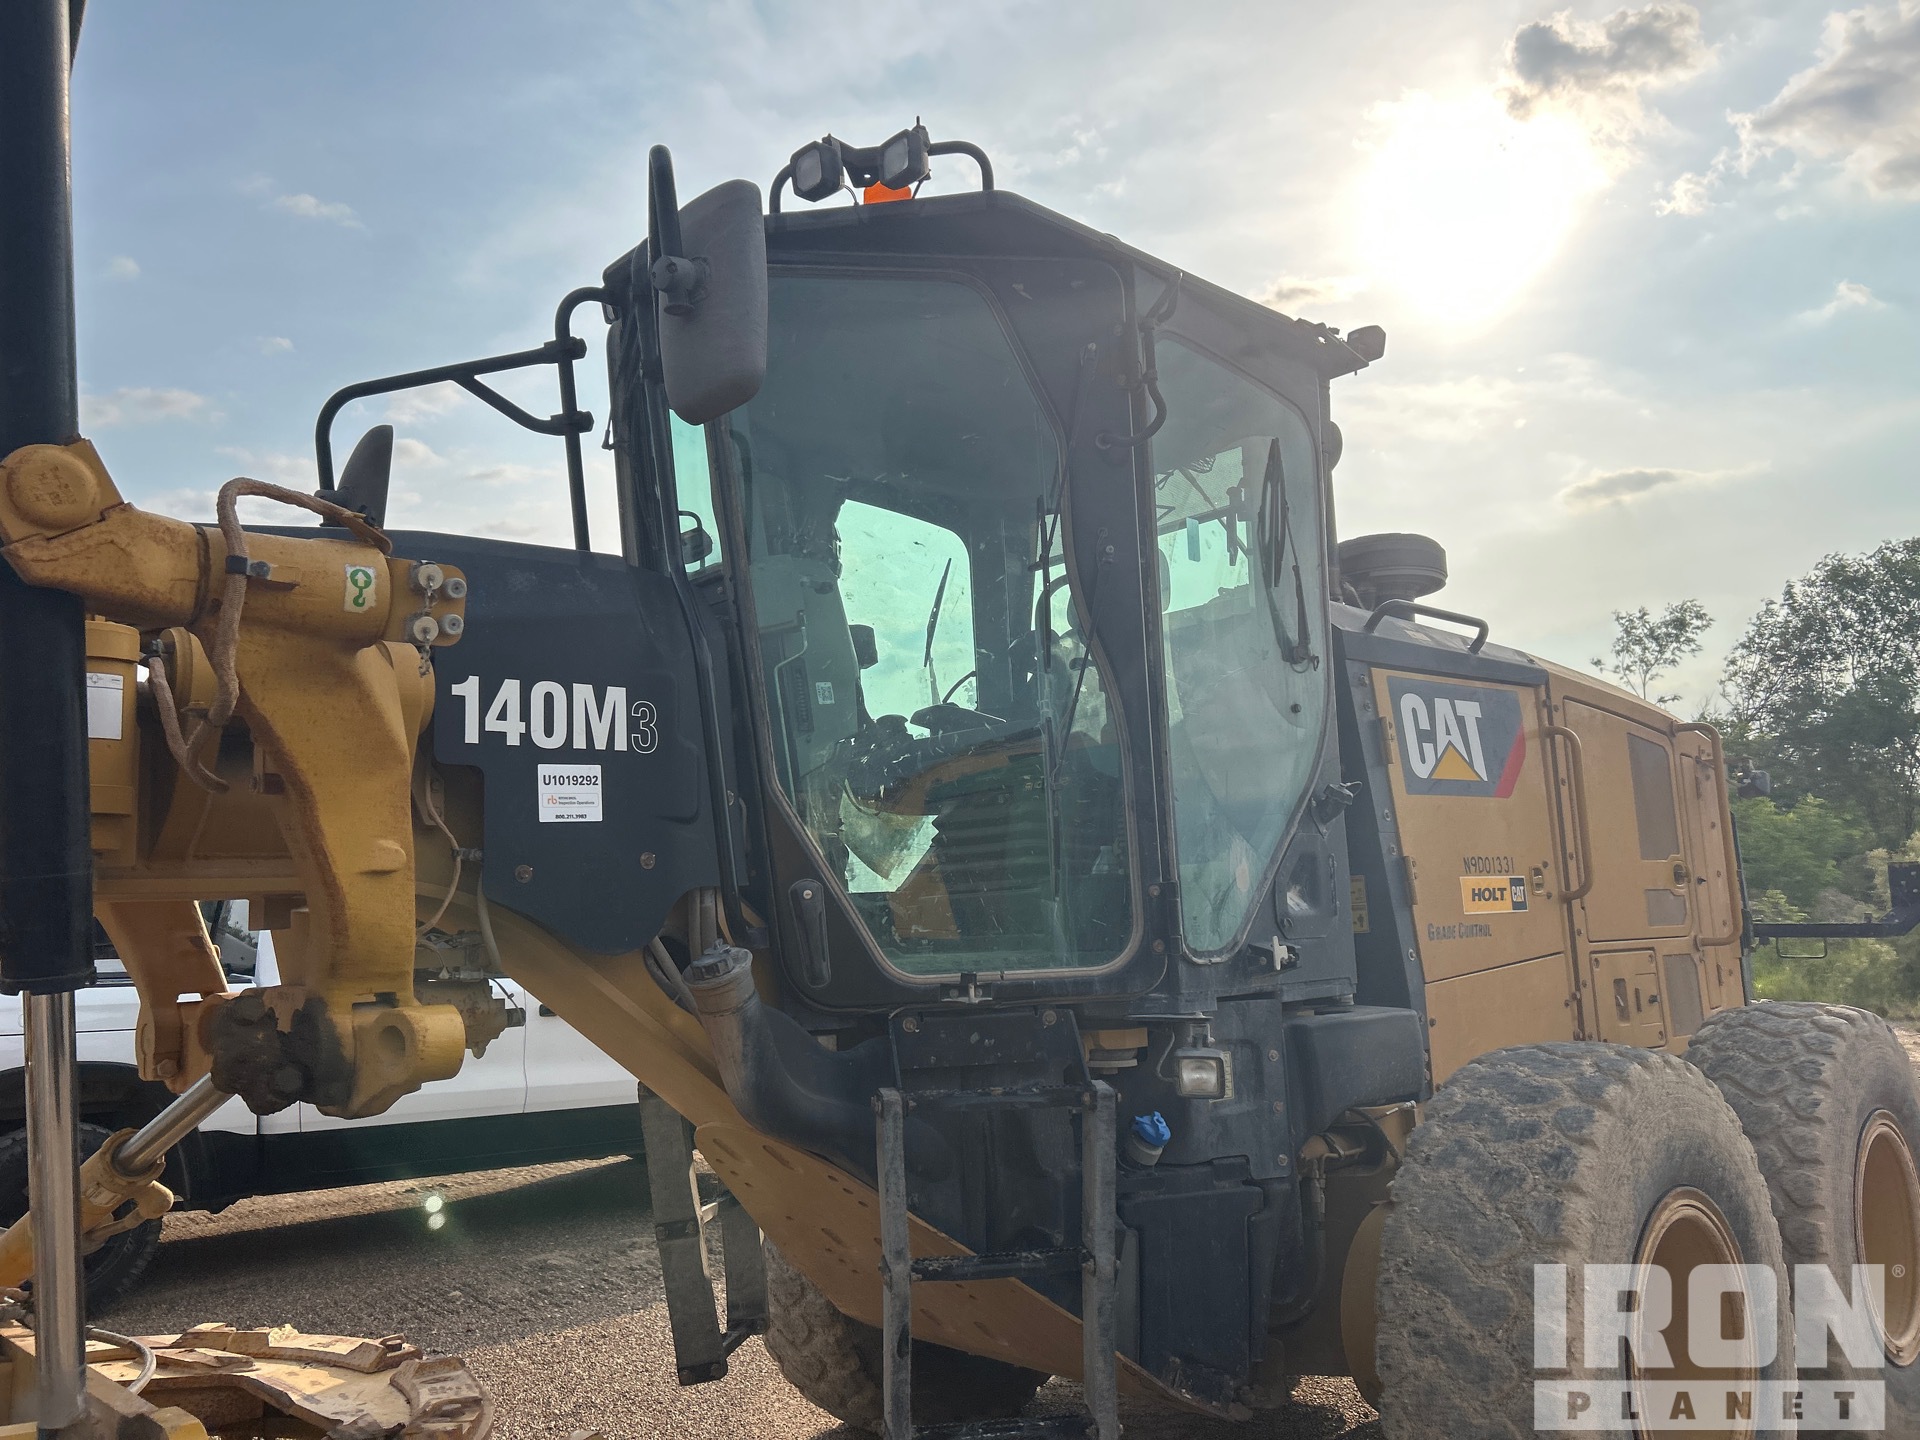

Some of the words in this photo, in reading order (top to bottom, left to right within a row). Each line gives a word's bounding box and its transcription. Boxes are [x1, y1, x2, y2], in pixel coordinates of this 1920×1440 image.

[1400, 692, 1488, 782] CAT
[543, 774, 599, 786] U1019292
[1463, 856, 1515, 875] N9D01331
[1471, 887, 1507, 902] HOLT
[1511, 885, 1525, 902] CAT
